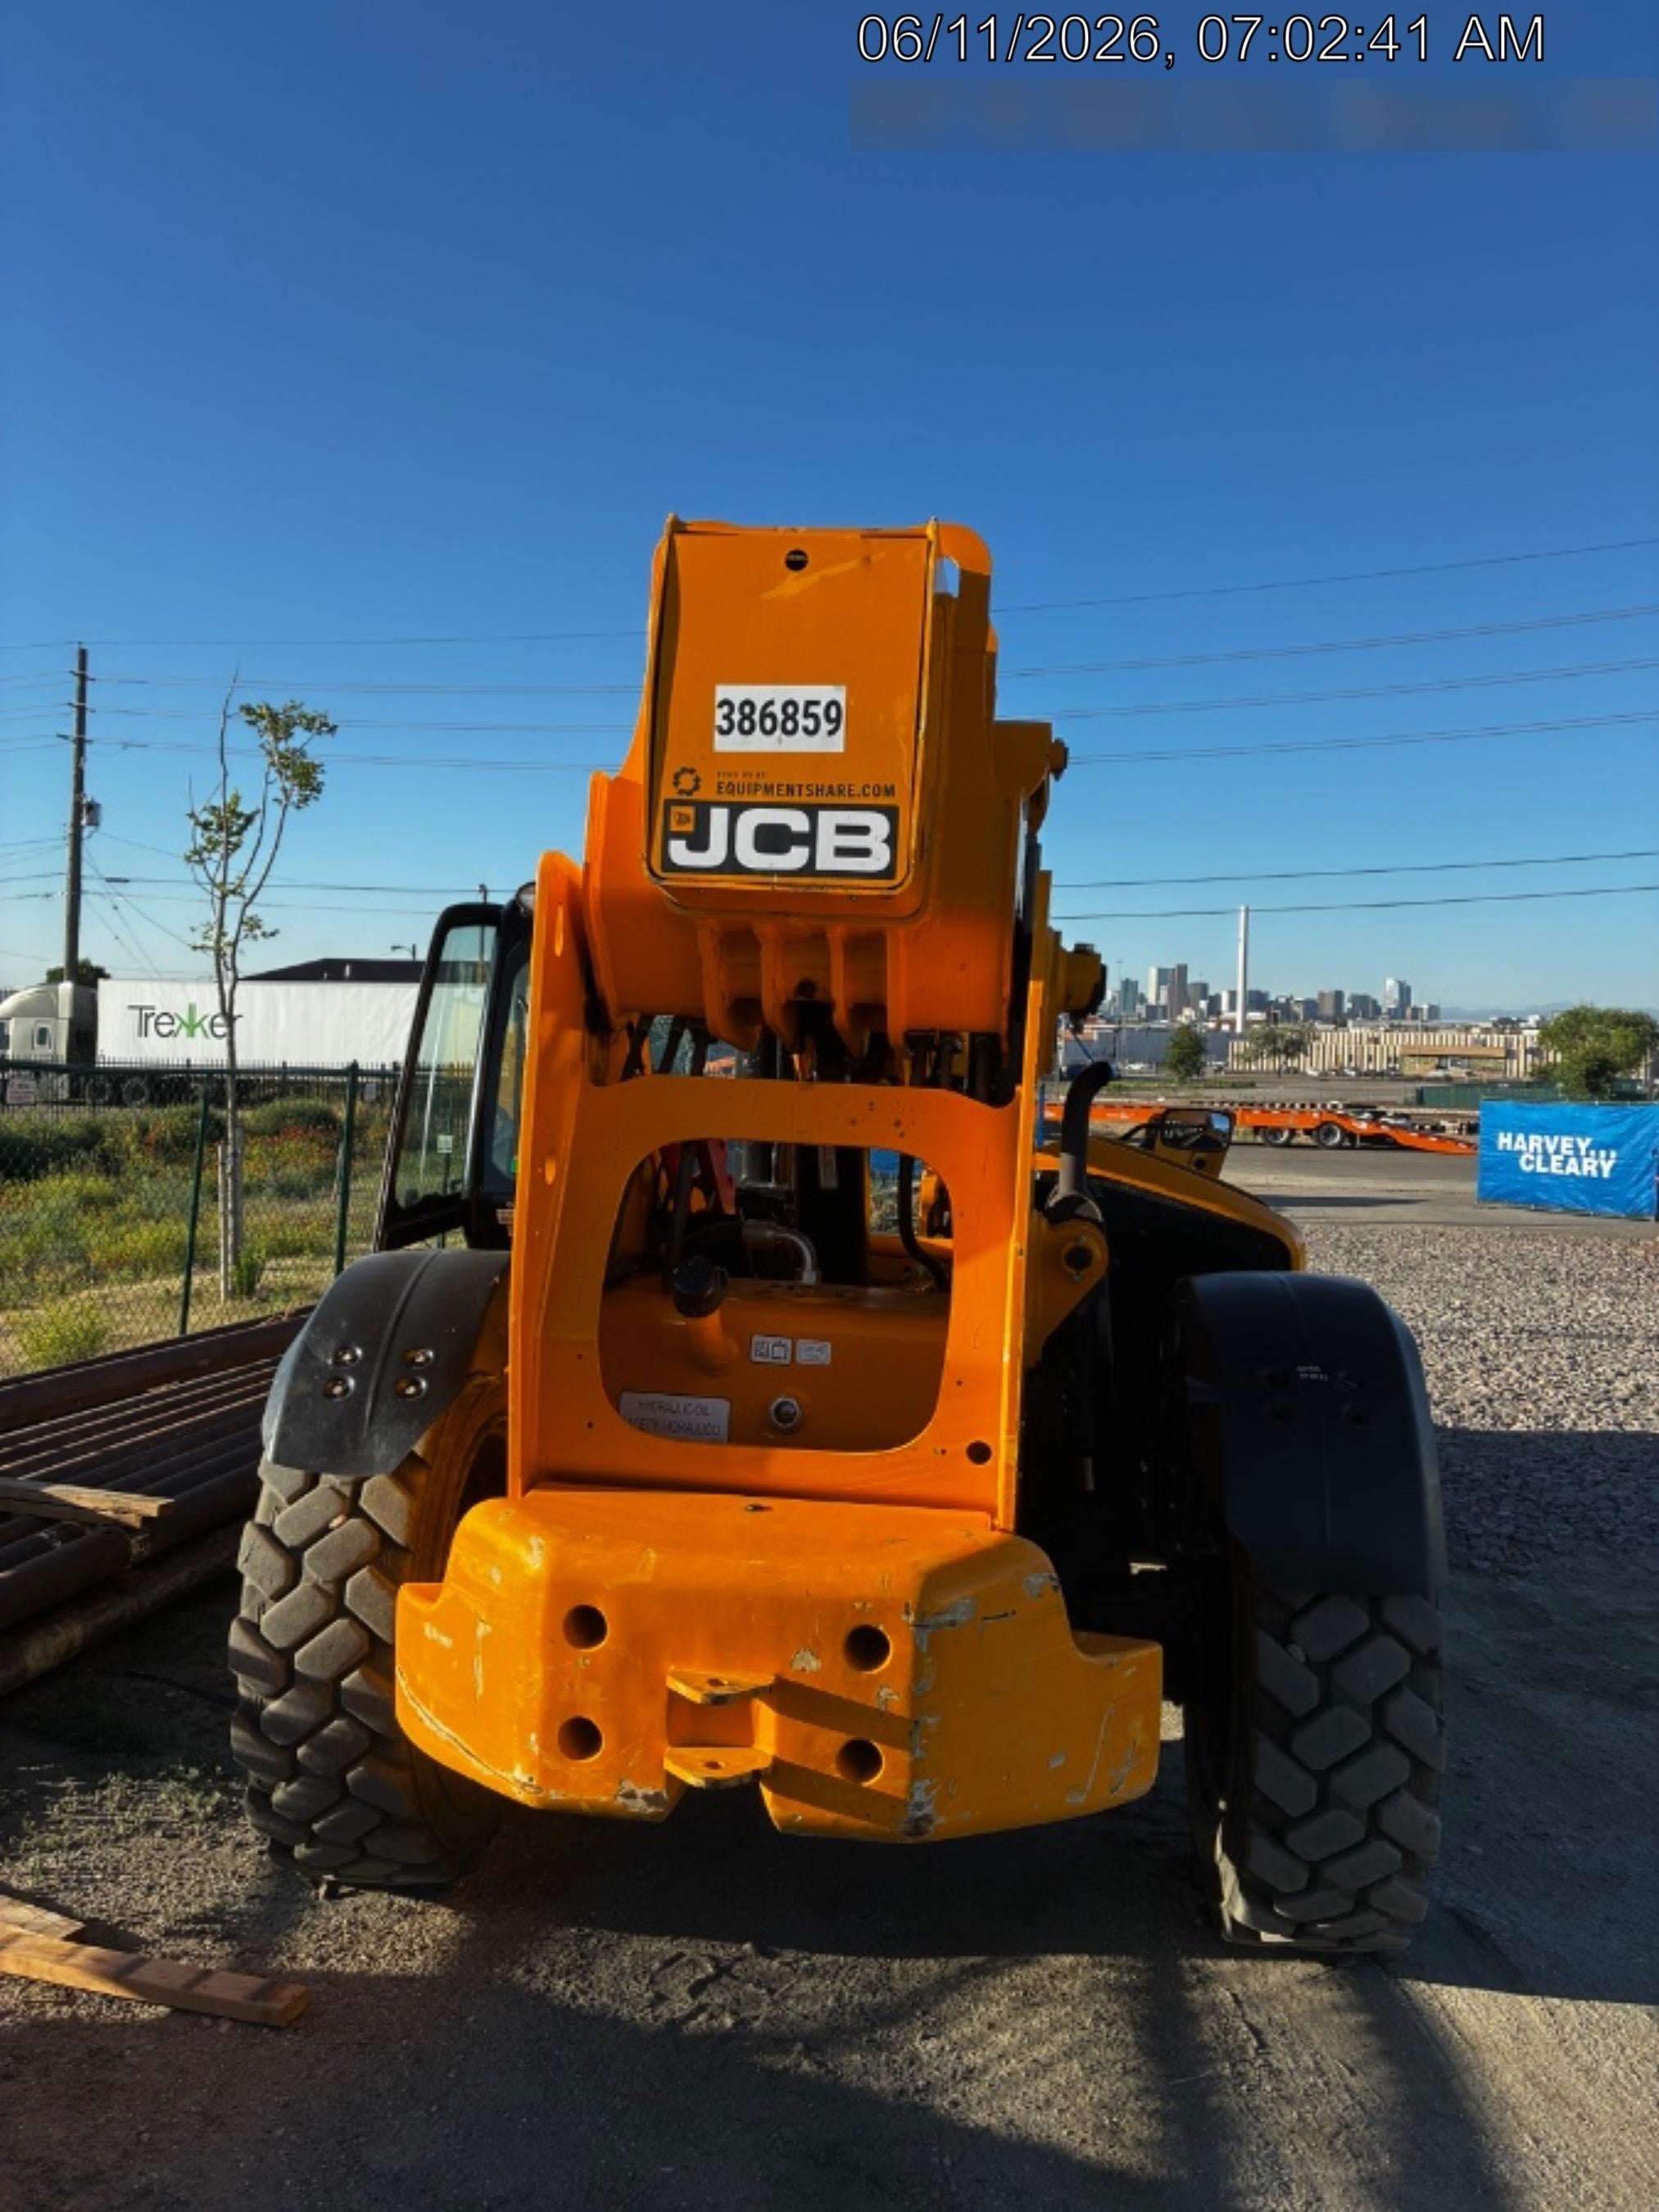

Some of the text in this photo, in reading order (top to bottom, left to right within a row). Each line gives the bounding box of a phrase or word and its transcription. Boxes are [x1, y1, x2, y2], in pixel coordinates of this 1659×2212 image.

[716, 698, 843, 737] 386859
[717, 781, 895, 798] EQUIPMENTSHARE.COM
[668, 806, 891, 872] JCB
[1519, 1154, 1616, 1178] CLEARY
